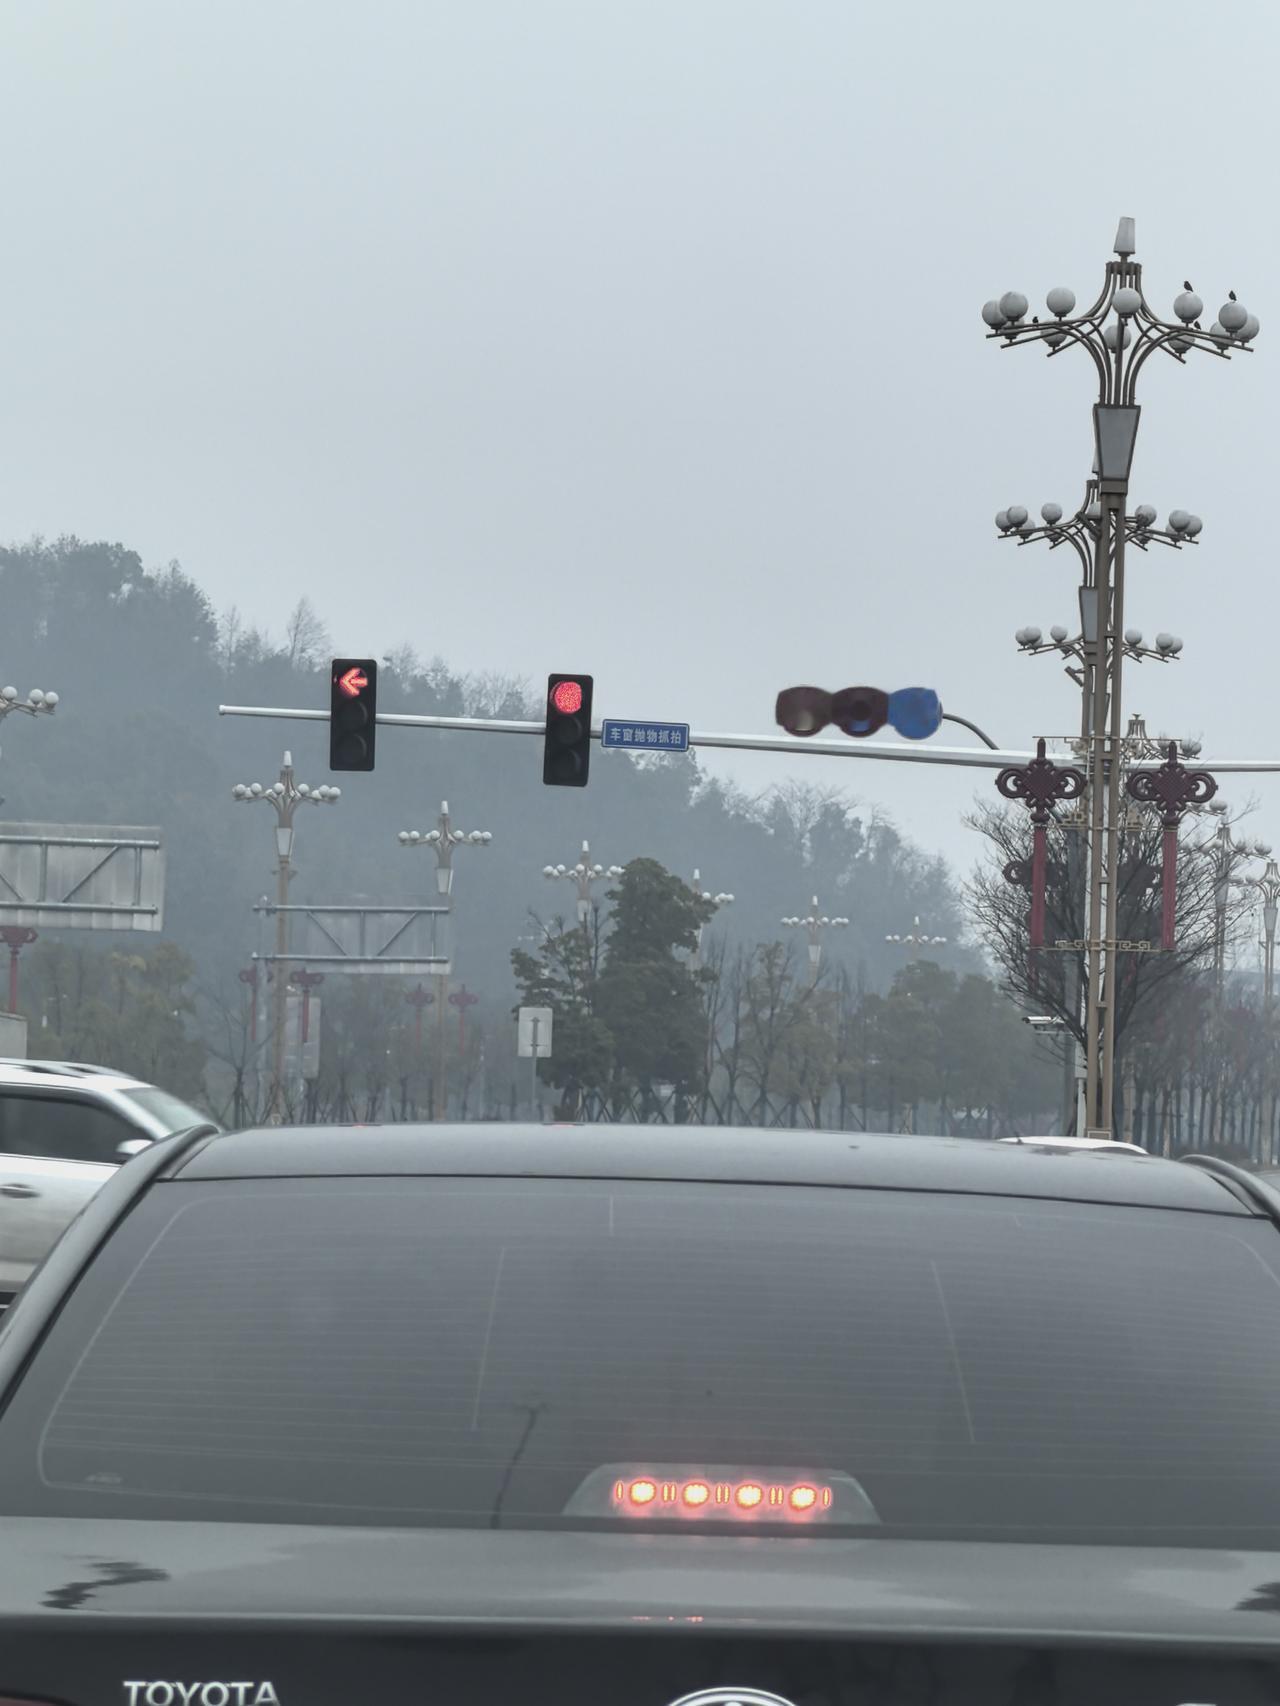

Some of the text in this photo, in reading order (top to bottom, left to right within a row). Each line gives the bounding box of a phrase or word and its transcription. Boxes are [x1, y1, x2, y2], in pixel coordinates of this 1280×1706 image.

[610, 727, 681, 744] 车窗抛物抓拍
[123, 1681, 281, 1706] TOYOTA
